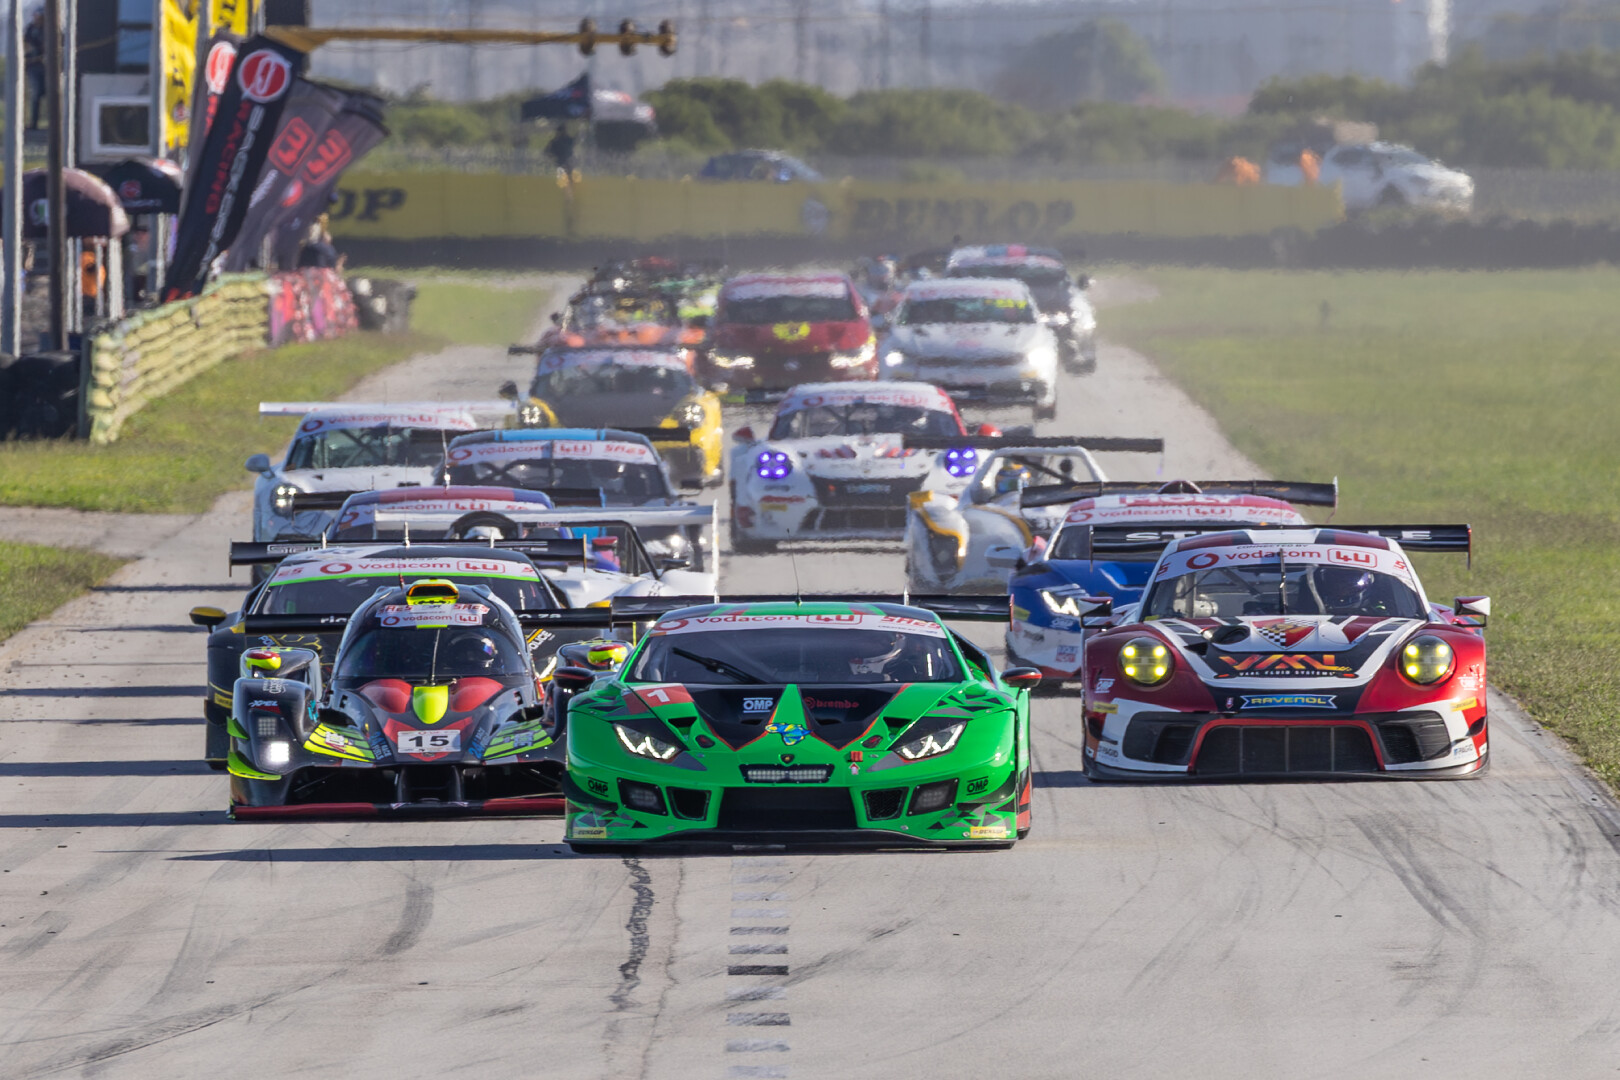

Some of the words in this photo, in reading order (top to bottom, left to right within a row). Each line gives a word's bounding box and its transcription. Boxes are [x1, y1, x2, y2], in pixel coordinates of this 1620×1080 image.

[1099, 507, 1183, 518] vodacom
[1225, 549, 1321, 560] vodacom
[358, 560, 451, 570] vodacom
[402, 613, 453, 621] vodacom
[695, 614, 800, 623] vodacom
[647, 689, 671, 702] 1
[1251, 696, 1327, 705] RAVENOL
[743, 699, 773, 712] OMP
[816, 698, 860, 709] brembo
[408, 735, 450, 747] 15
[587, 779, 609, 794] OMP
[966, 778, 989, 793] OMP
